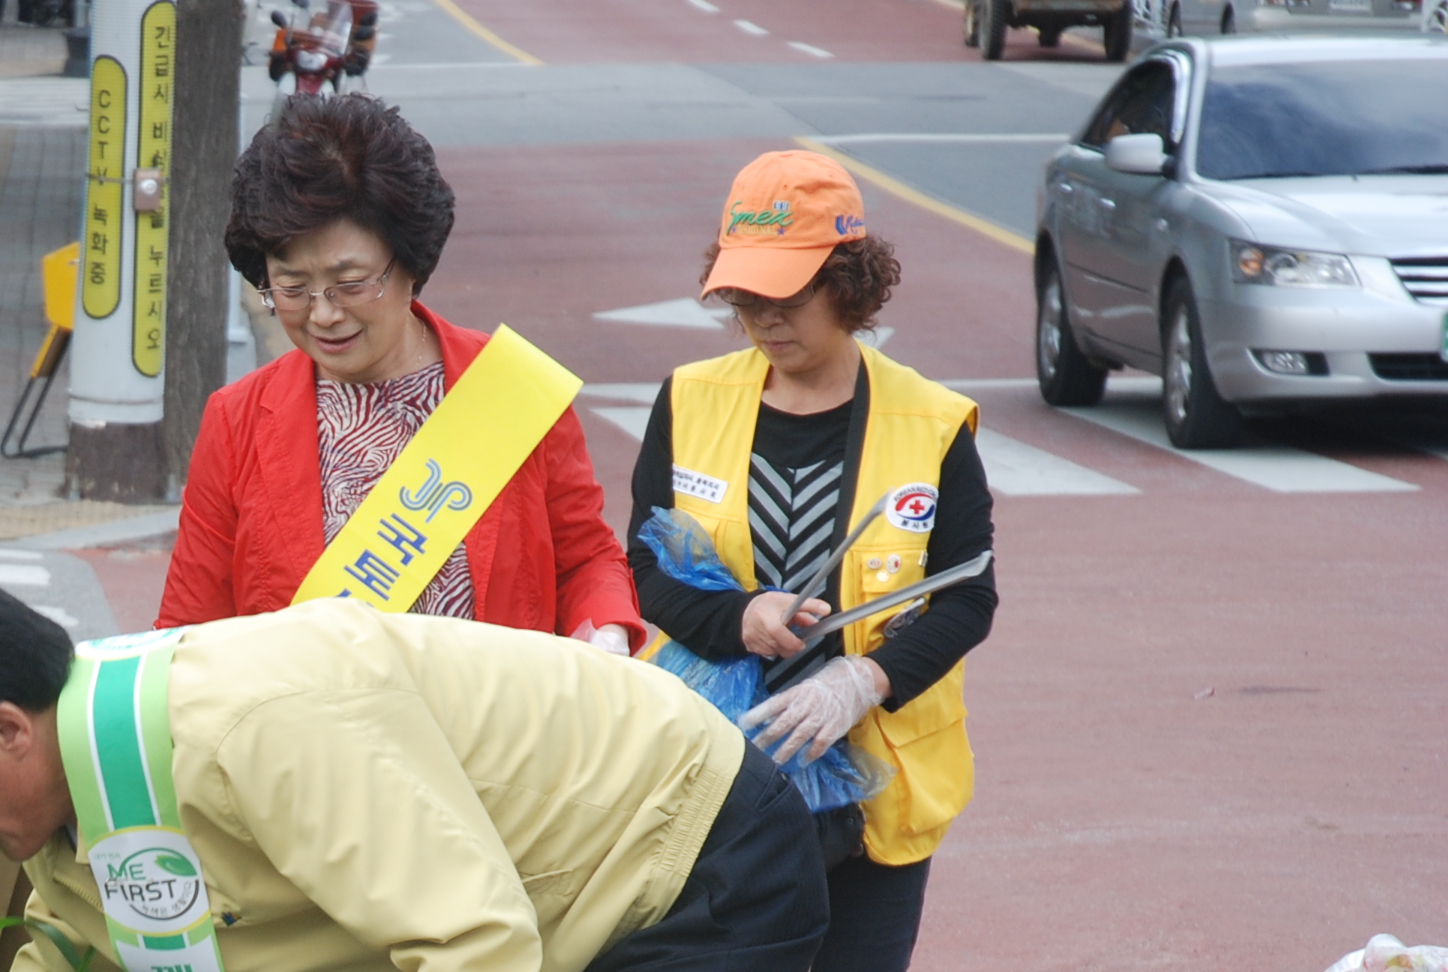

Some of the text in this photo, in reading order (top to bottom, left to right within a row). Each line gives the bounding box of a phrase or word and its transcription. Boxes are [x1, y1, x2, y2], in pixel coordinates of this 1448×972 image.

[96, 89, 112, 186] CCTV
[146, 25, 170, 351] 긴급시 비상을 누르시오
[104, 880, 176, 902] FIRST
[106, 862, 146, 881] ME
